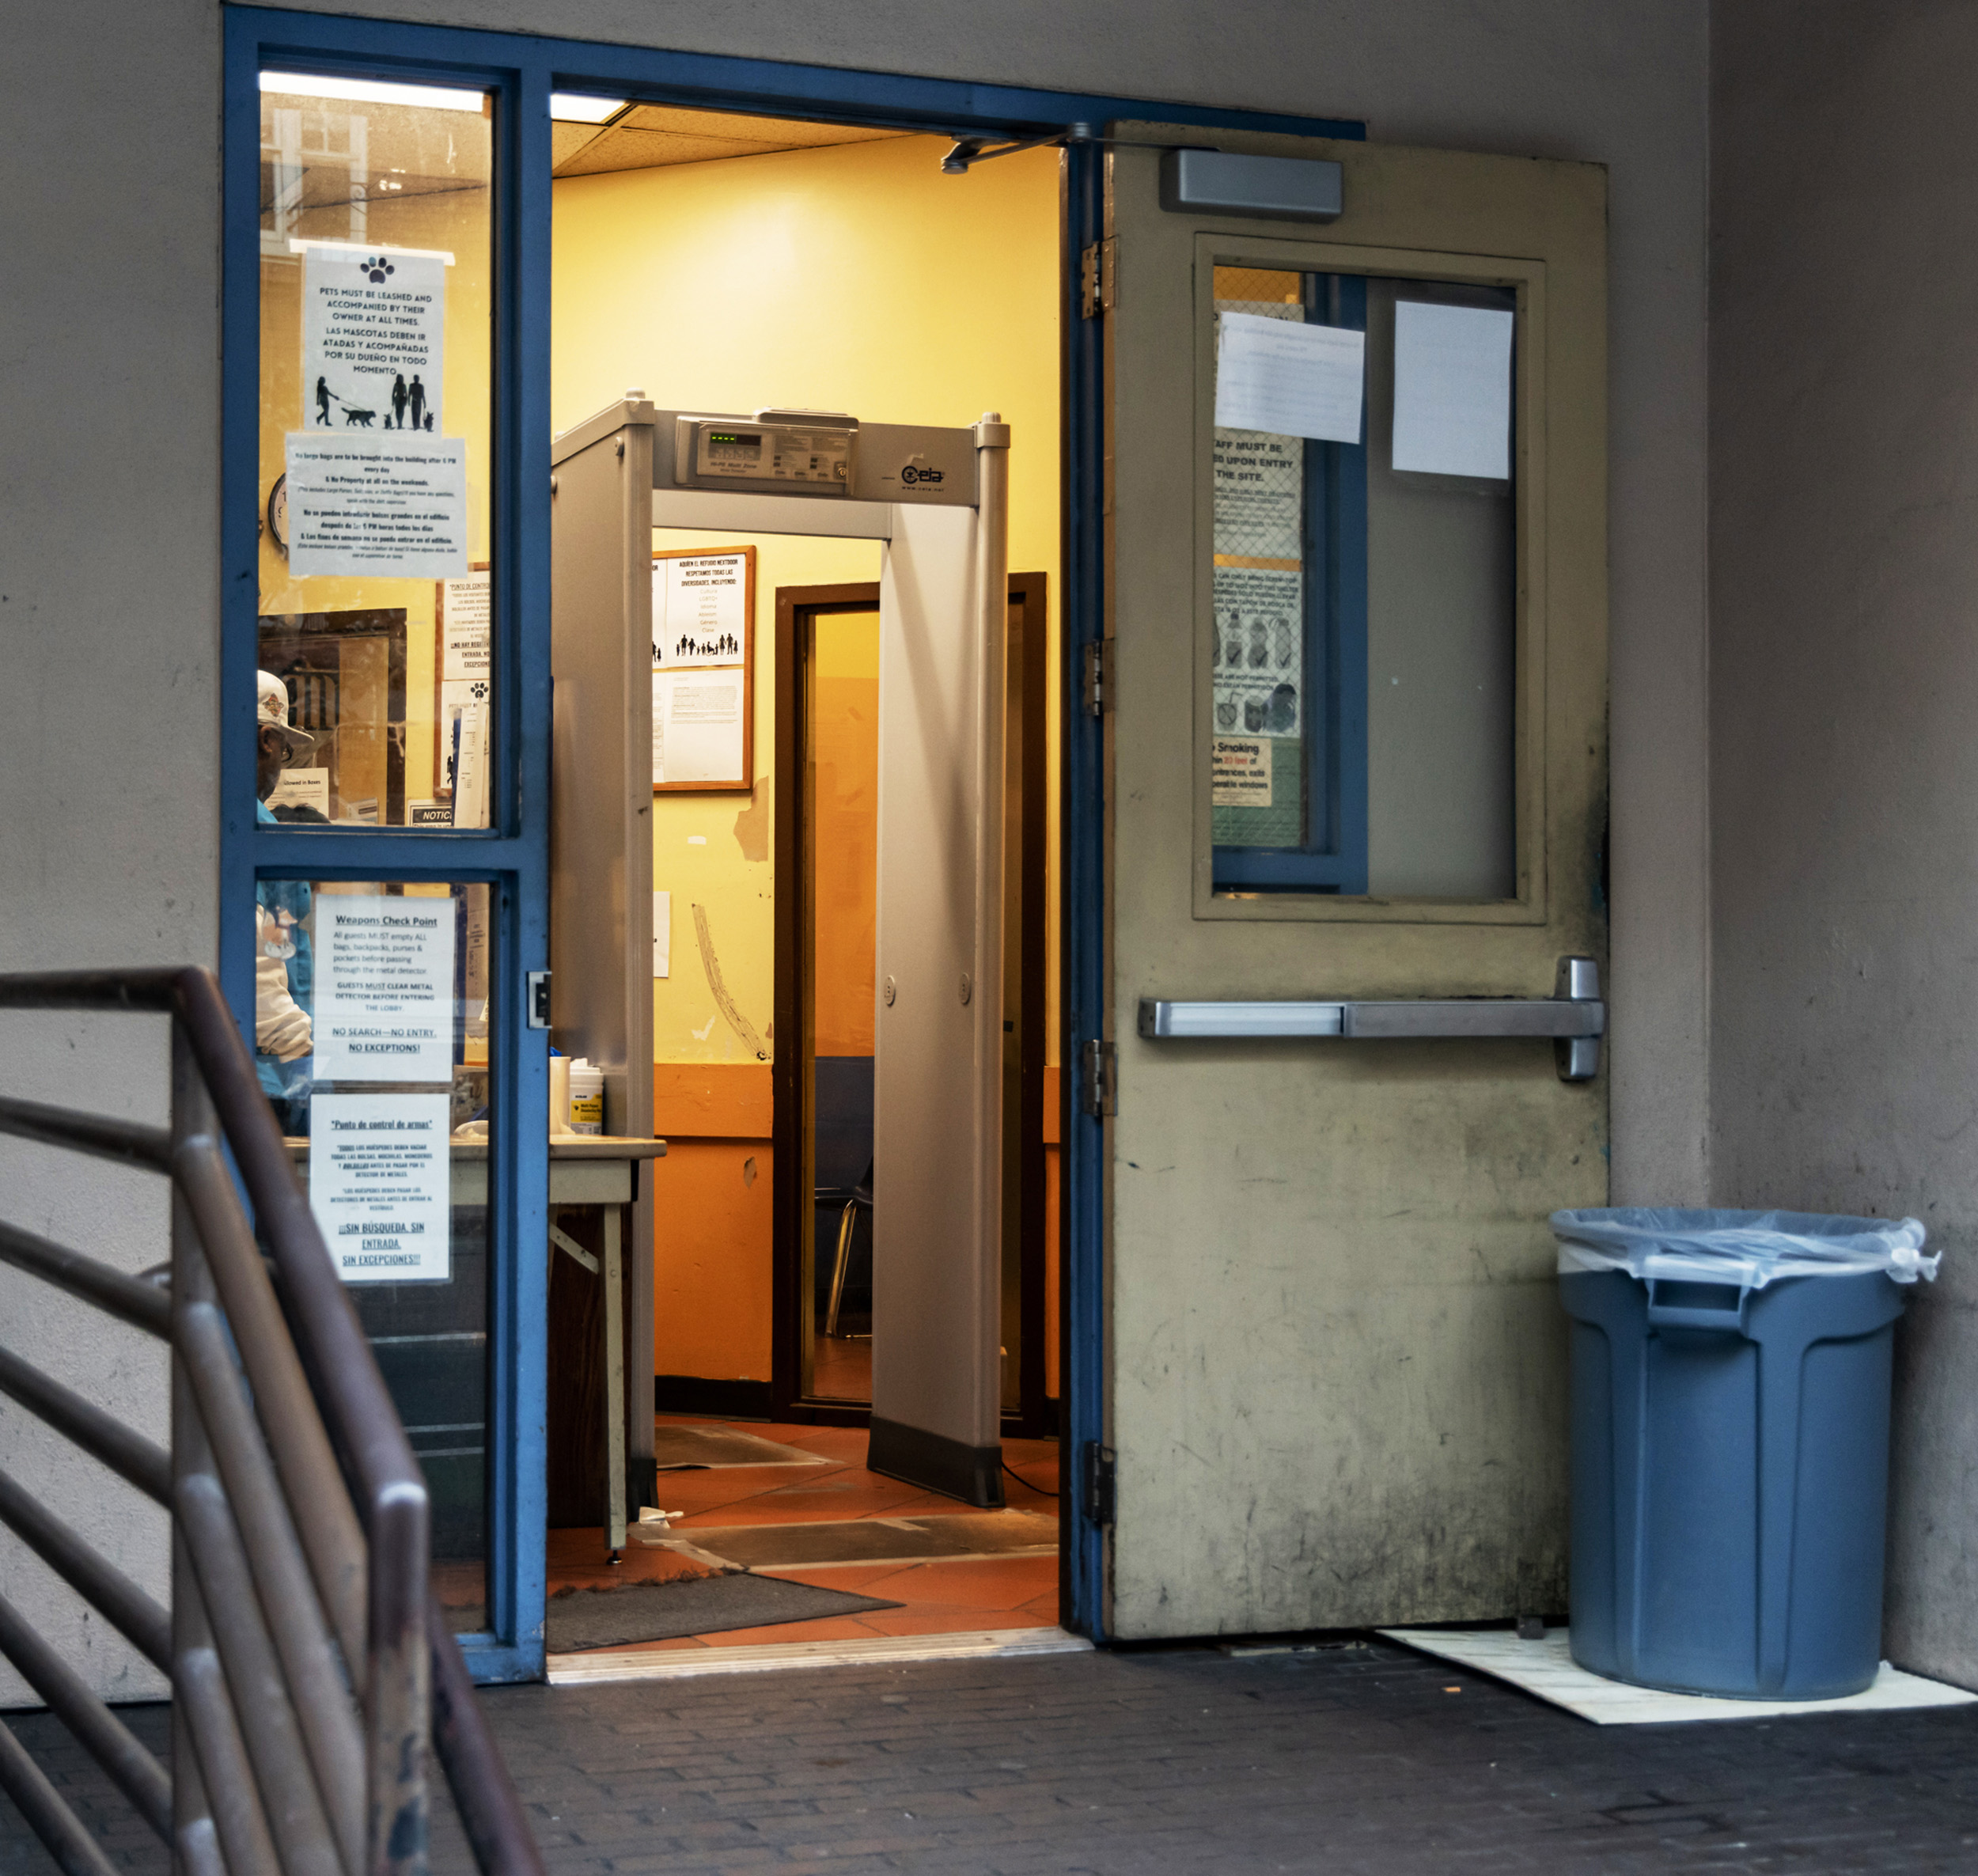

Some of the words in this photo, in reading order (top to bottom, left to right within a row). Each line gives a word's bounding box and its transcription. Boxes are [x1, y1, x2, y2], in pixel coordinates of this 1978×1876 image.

[378, 292, 412, 301] LEASHED
[328, 301, 387, 311] ACCOMPANIED
[333, 313, 363, 322] OWNER
[343, 329, 387, 338] MASCOTAS
[366, 343, 428, 353] ACOMPAÑADAS
[358, 354, 387, 362] DUEÑO
[1236, 442, 1266, 451] MUST
[1269, 444, 1283, 453] BE
[1226, 457, 1256, 466] UPON
[1260, 458, 1294, 468] ENTRY
[1216, 470, 1235, 479] THE
[1237, 472, 1264, 482] SITE.
[1218, 742, 1260, 756] Smoking
[1239, 781, 1268, 790] windows
[423, 811, 452, 820] NOTIC
[335, 915, 380, 926] Weapons
[383, 916, 410, 927] Check
[413, 918, 437, 927] Point
[332, 1028, 345, 1037] NO
[358, 1120, 366, 1129] de
[369, 1120, 395, 1129] control
[396, 1120, 405, 1129] de
[411, 1222, 424, 1233] SIN
[343, 1256, 356, 1265] SIN
